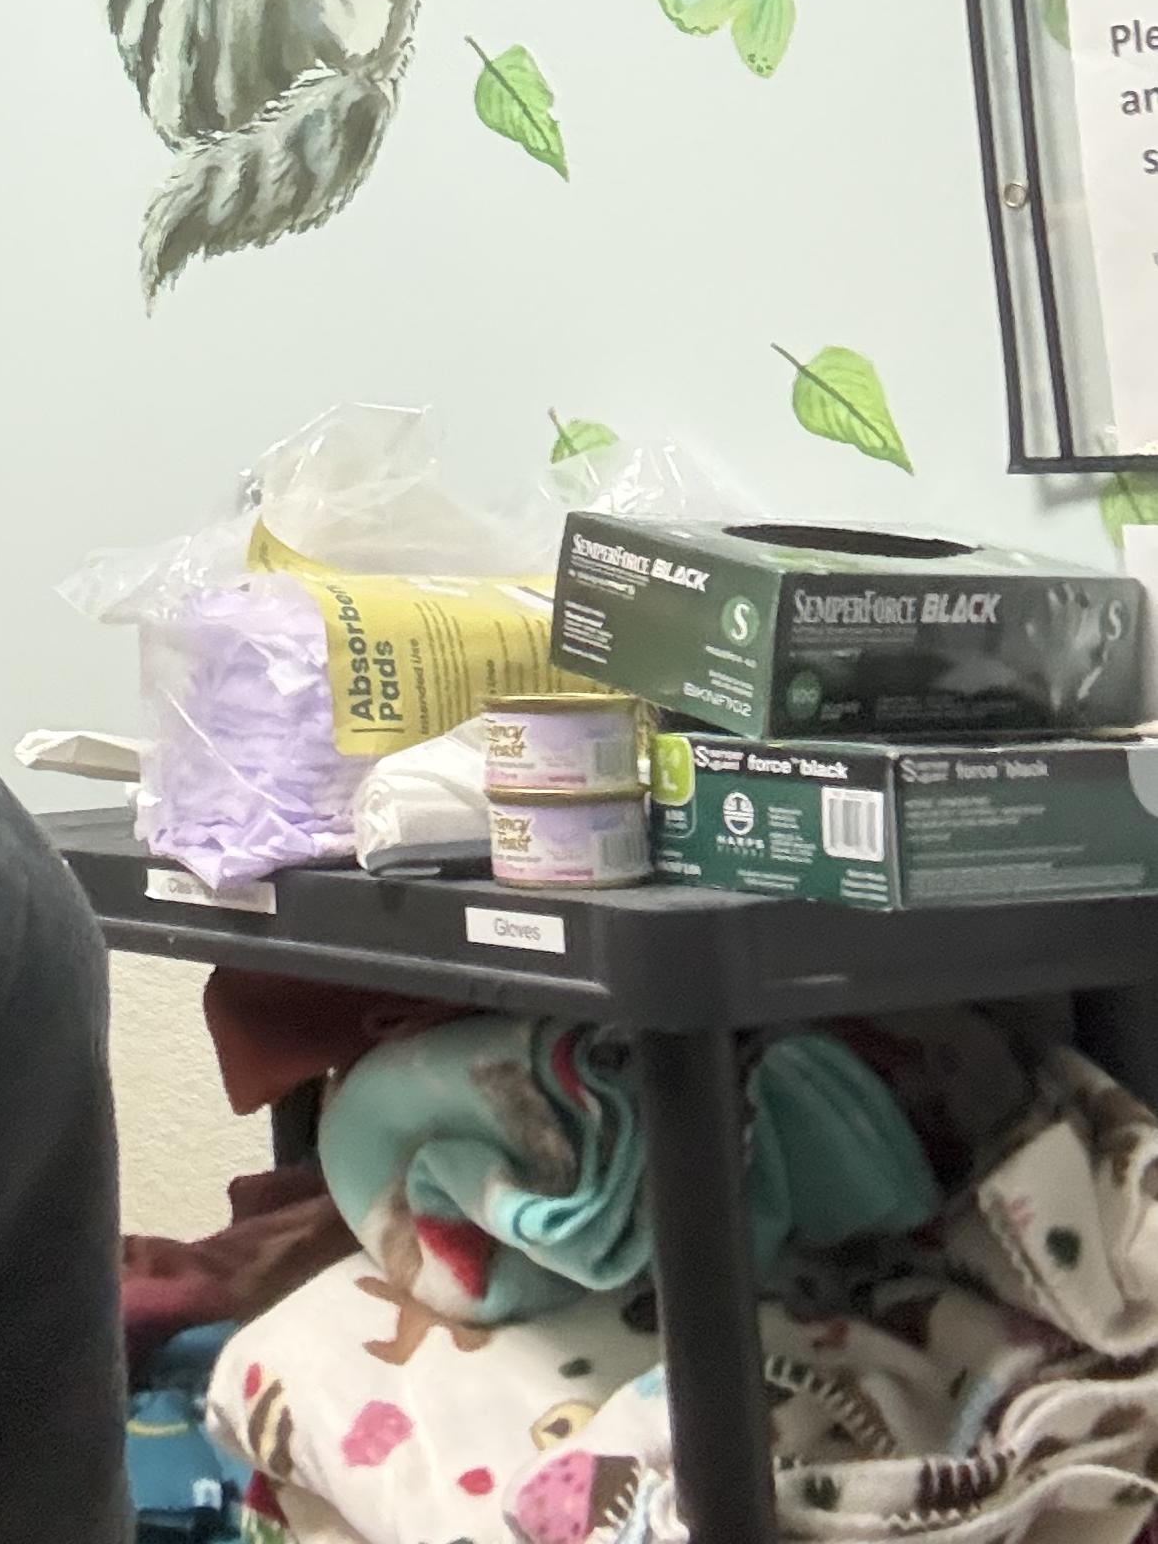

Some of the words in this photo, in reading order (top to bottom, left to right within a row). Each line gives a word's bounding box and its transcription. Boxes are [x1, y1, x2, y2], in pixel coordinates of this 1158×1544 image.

[650, 558, 710, 593] BLACK
[920, 592, 1002, 624] BLACK
[374, 639, 405, 722] Pads
[799, 759, 849, 779] black
[494, 917, 541, 941] Gloves
